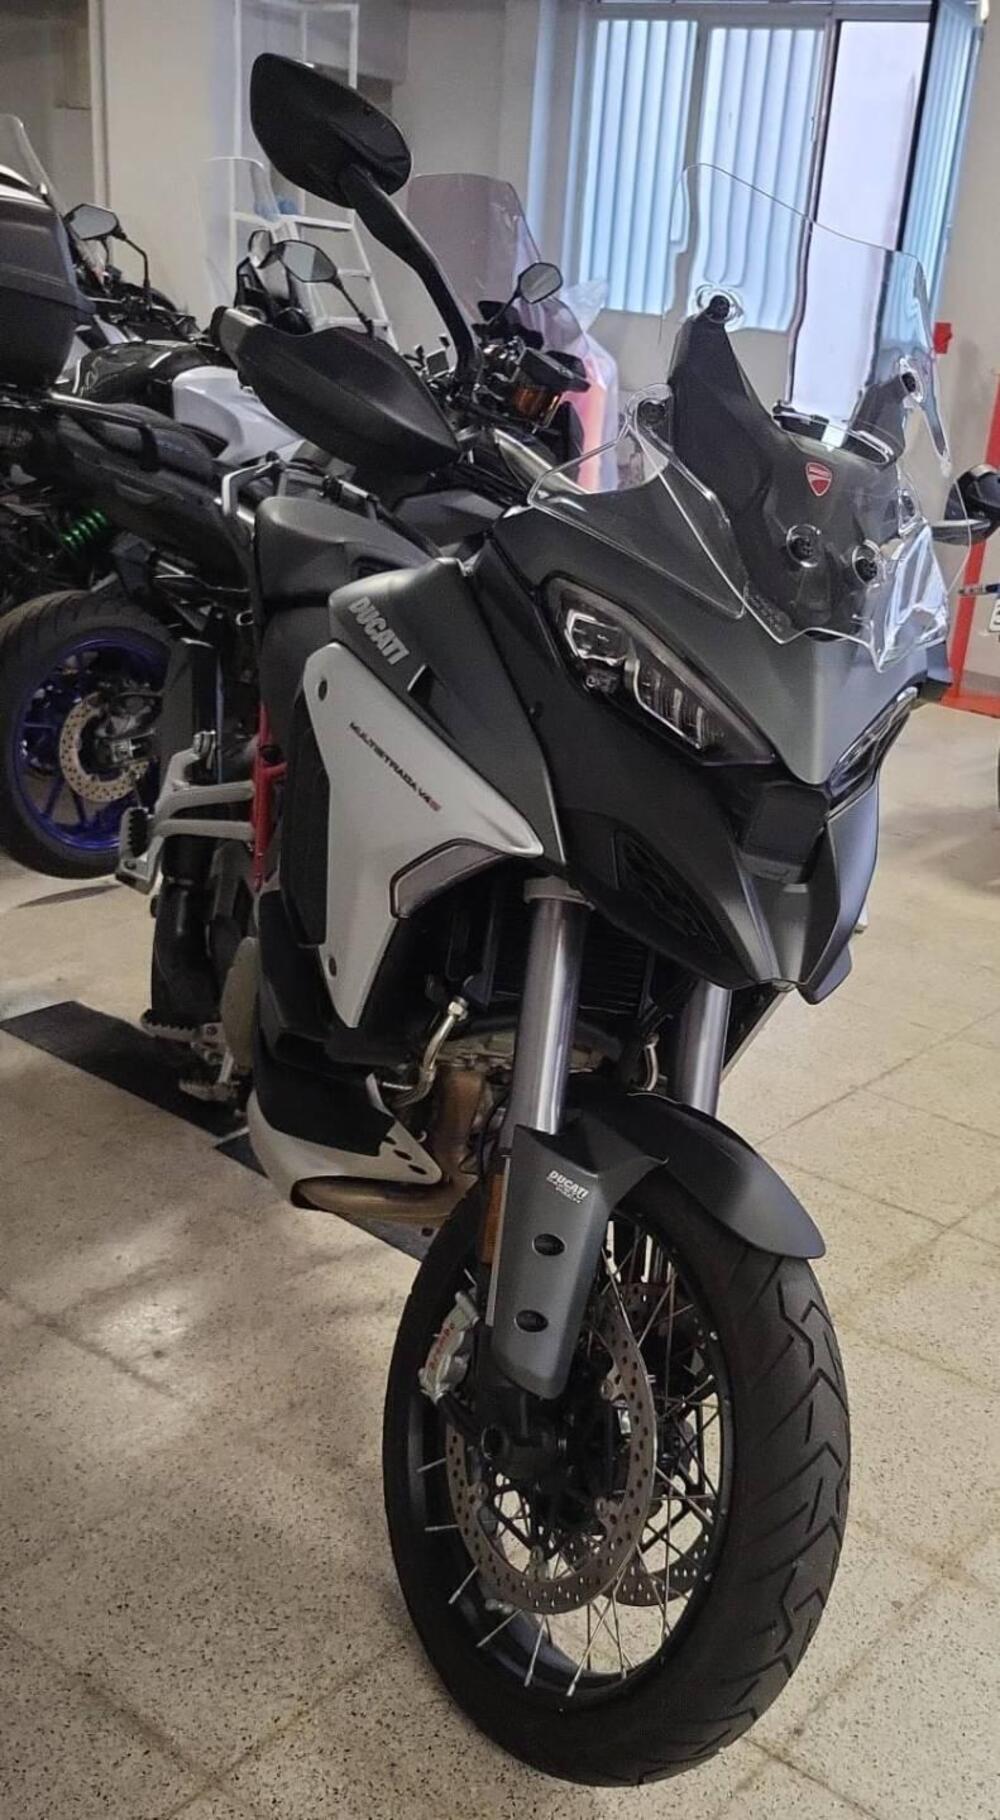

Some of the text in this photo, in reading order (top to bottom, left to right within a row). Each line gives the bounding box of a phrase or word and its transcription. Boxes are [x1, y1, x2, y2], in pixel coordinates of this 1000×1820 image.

[348, 596, 410, 665] DUCATI
[349, 722, 417, 792] MULTISTRADA
[548, 1170, 589, 1199] DUCATI
